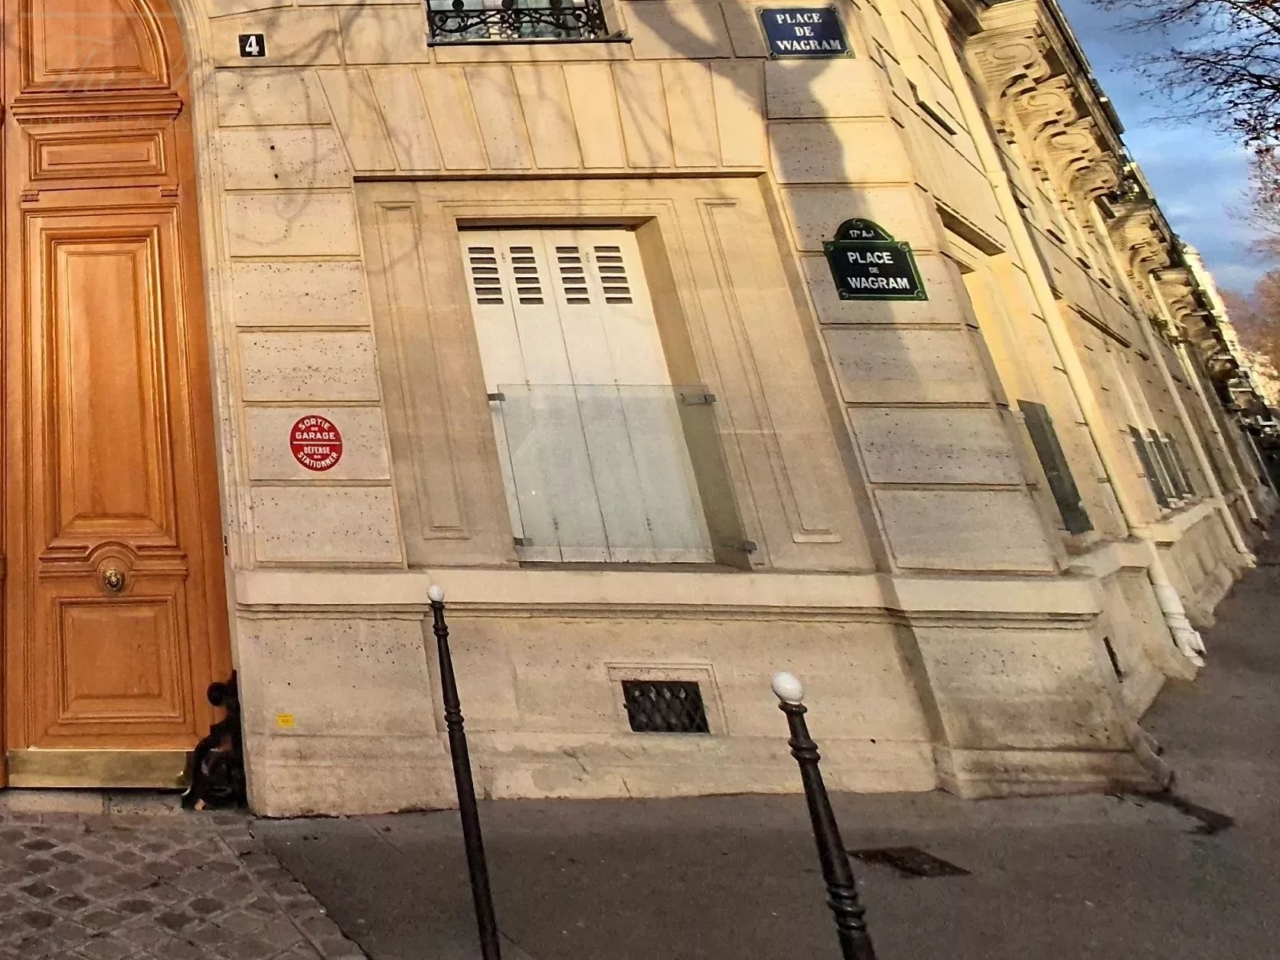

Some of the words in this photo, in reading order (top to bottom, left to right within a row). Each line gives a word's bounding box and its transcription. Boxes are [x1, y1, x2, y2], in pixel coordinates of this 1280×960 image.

[776, 12, 822, 24] PLACE
[794, 26, 814, 37] DE
[245, 35, 259, 56] 4
[776, 39, 842, 51] WAGRAM
[847, 251, 894, 264] PLACE
[847, 277, 910, 289] WAGRAM
[298, 418, 331, 431] SORTIE
[295, 431, 335, 440] GARAGE
[297, 451, 339, 468] STATIONNER
